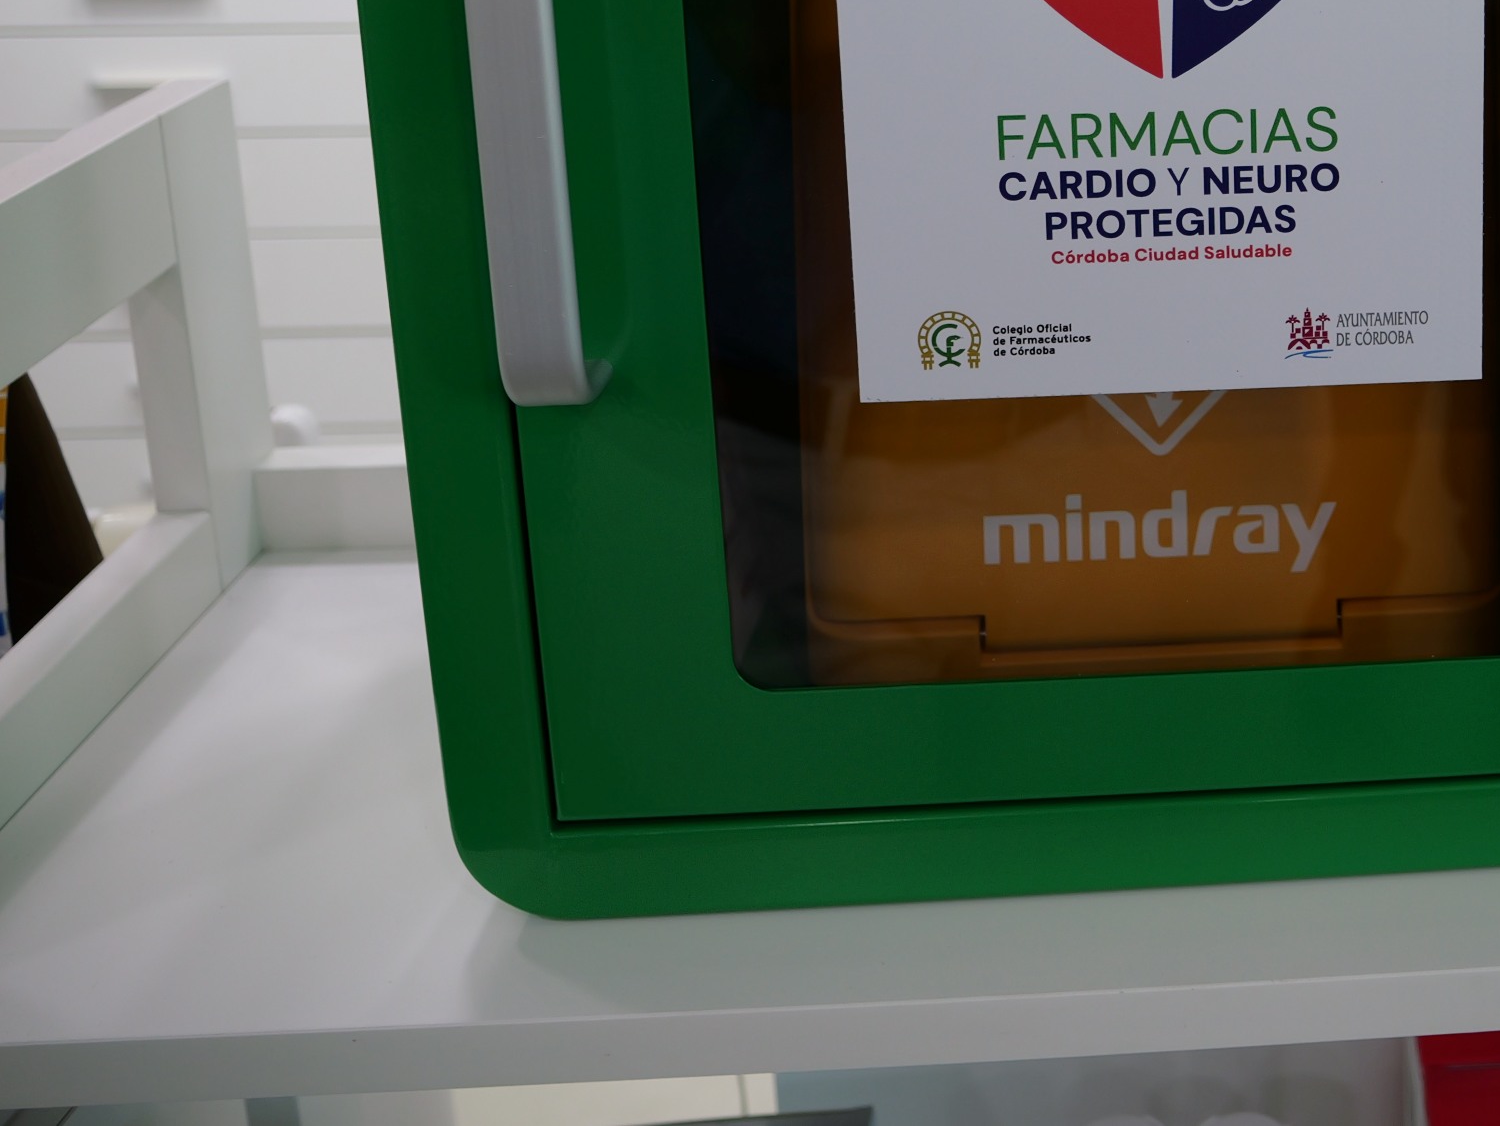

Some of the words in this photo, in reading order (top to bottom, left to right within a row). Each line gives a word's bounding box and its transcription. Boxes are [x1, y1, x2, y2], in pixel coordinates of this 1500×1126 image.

[997, 106, 1339, 161] FARMACIAS
[999, 168, 1156, 201] CARDIO
[1167, 167, 1189, 196] Y
[1203, 163, 1339, 195] NEURO
[1045, 205, 1297, 241] PROTEGIDAS
[1051, 248, 1130, 265] Córdoba
[1135, 245, 1199, 262] Ciudad
[1204, 243, 1293, 260] Saludable
[1336, 310, 1429, 328] AYUNTAMIENTO
[992, 325, 1034, 337] Colegio
[1037, 323, 1072, 334] Oficial
[993, 336, 1006, 346] de
[1010, 334, 1092, 346] Farmacéuticos
[1336, 331, 1354, 347] DE
[1357, 328, 1415, 346] CÓRDOBA
[993, 348, 1007, 357] de
[1010, 346, 1056, 357] Córdoba
[982, 490, 1337, 573] mindray
